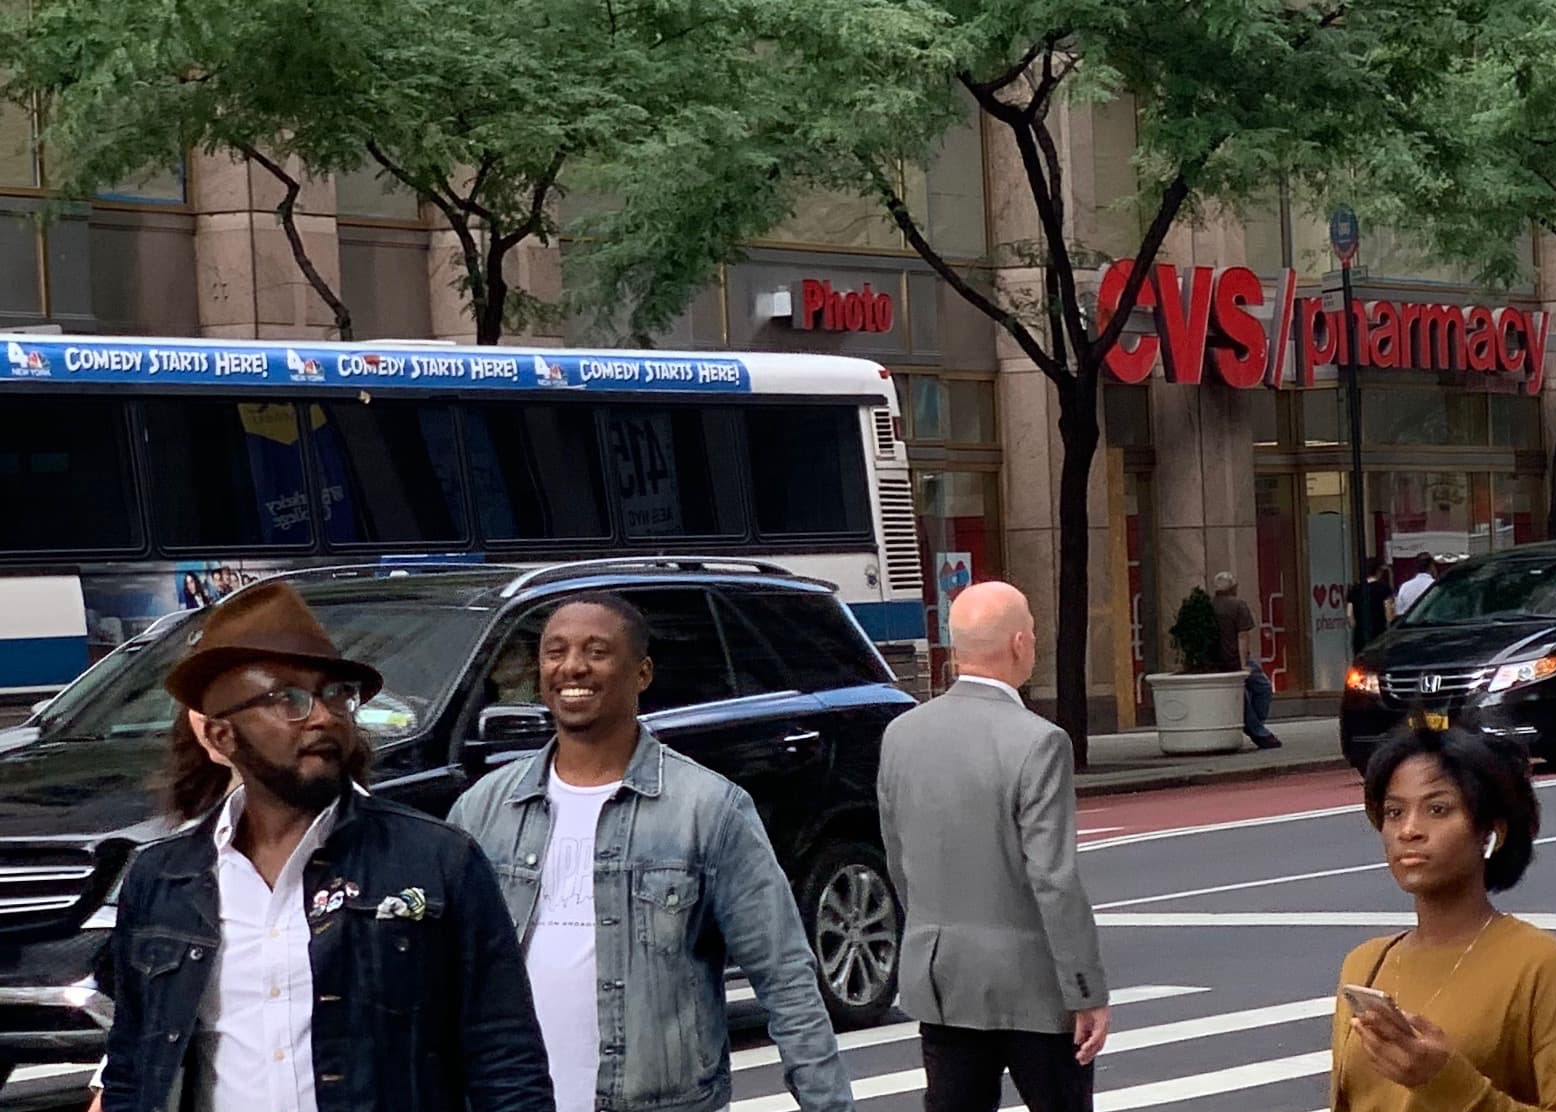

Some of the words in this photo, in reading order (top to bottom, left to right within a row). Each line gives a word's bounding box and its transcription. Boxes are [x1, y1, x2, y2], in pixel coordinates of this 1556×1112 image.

[802, 278, 893, 333] Photo
[64, 346, 143, 372] COMEDY
[149, 348, 209, 375] STARTS
[214, 351, 269, 378] HERE!
[410, 354, 465, 380] STARTS
[469, 357, 519, 382] HERE!
[579, 358, 640, 383] COMEDY
[645, 362, 694, 383] STARTS
[699, 363, 741, 386] HERE!
